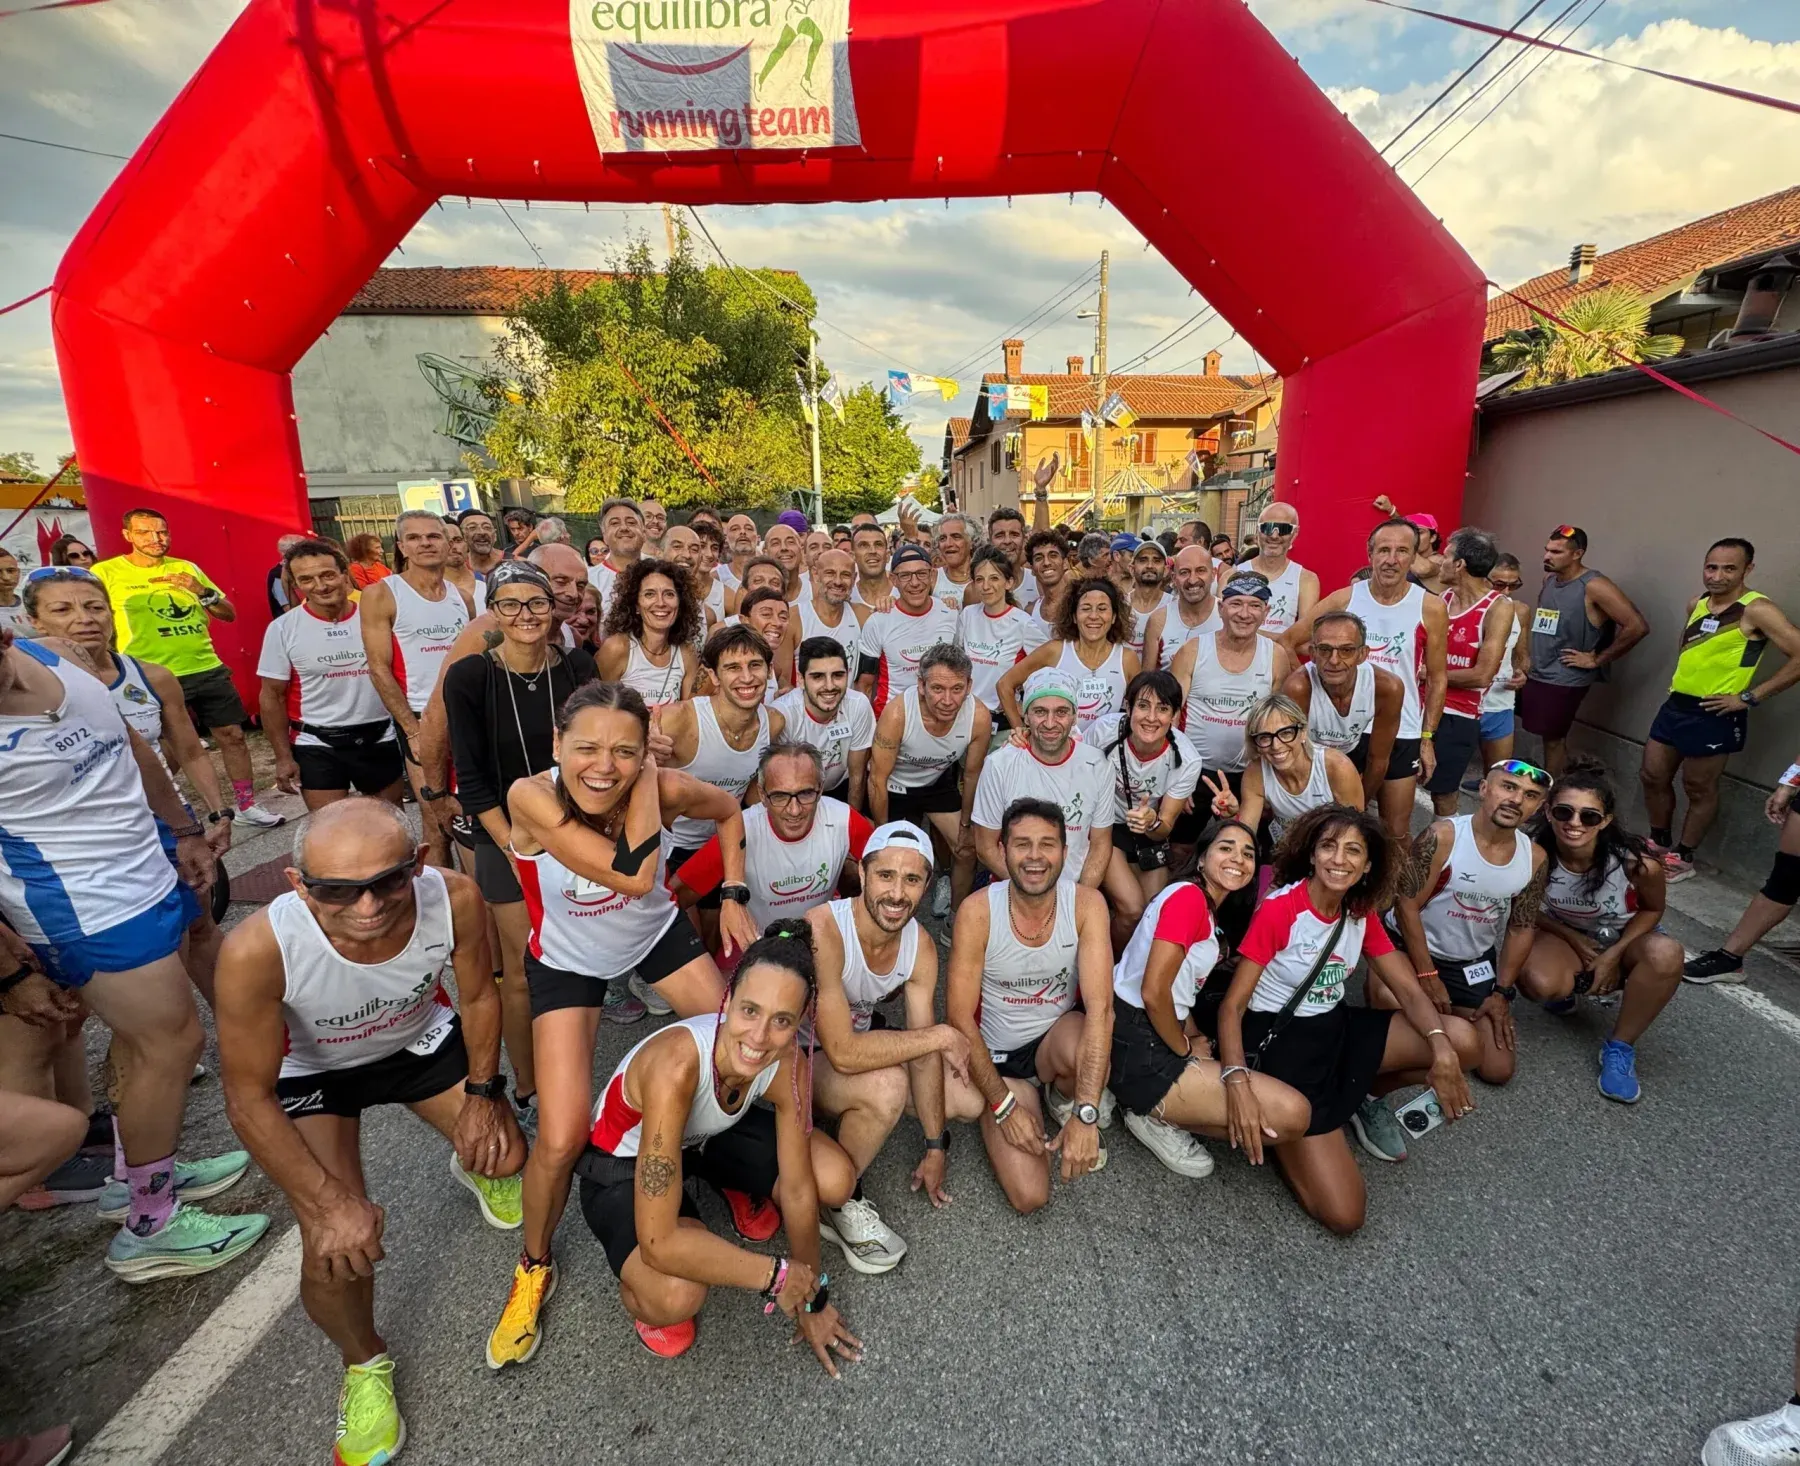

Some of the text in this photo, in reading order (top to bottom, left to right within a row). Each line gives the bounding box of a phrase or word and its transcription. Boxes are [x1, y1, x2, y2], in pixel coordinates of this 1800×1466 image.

[591, 0, 772, 44] equilibra
[450, 486, 466, 509] P
[327, 629, 349, 637] 8805
[416, 623, 456, 636] equilibra
[316, 650, 365, 664] equilibra
[1085, 683, 1105, 691] 8819
[1202, 696, 1245, 708] equilibra
[829, 727, 851, 737] 8813
[54, 727, 92, 753] 8072
[568, 898, 624, 917] running
[769, 895, 806, 907] running
[1468, 965, 1490, 980] 2631
[1002, 996, 1044, 1006] running
[314, 997, 408, 1027] equilibra
